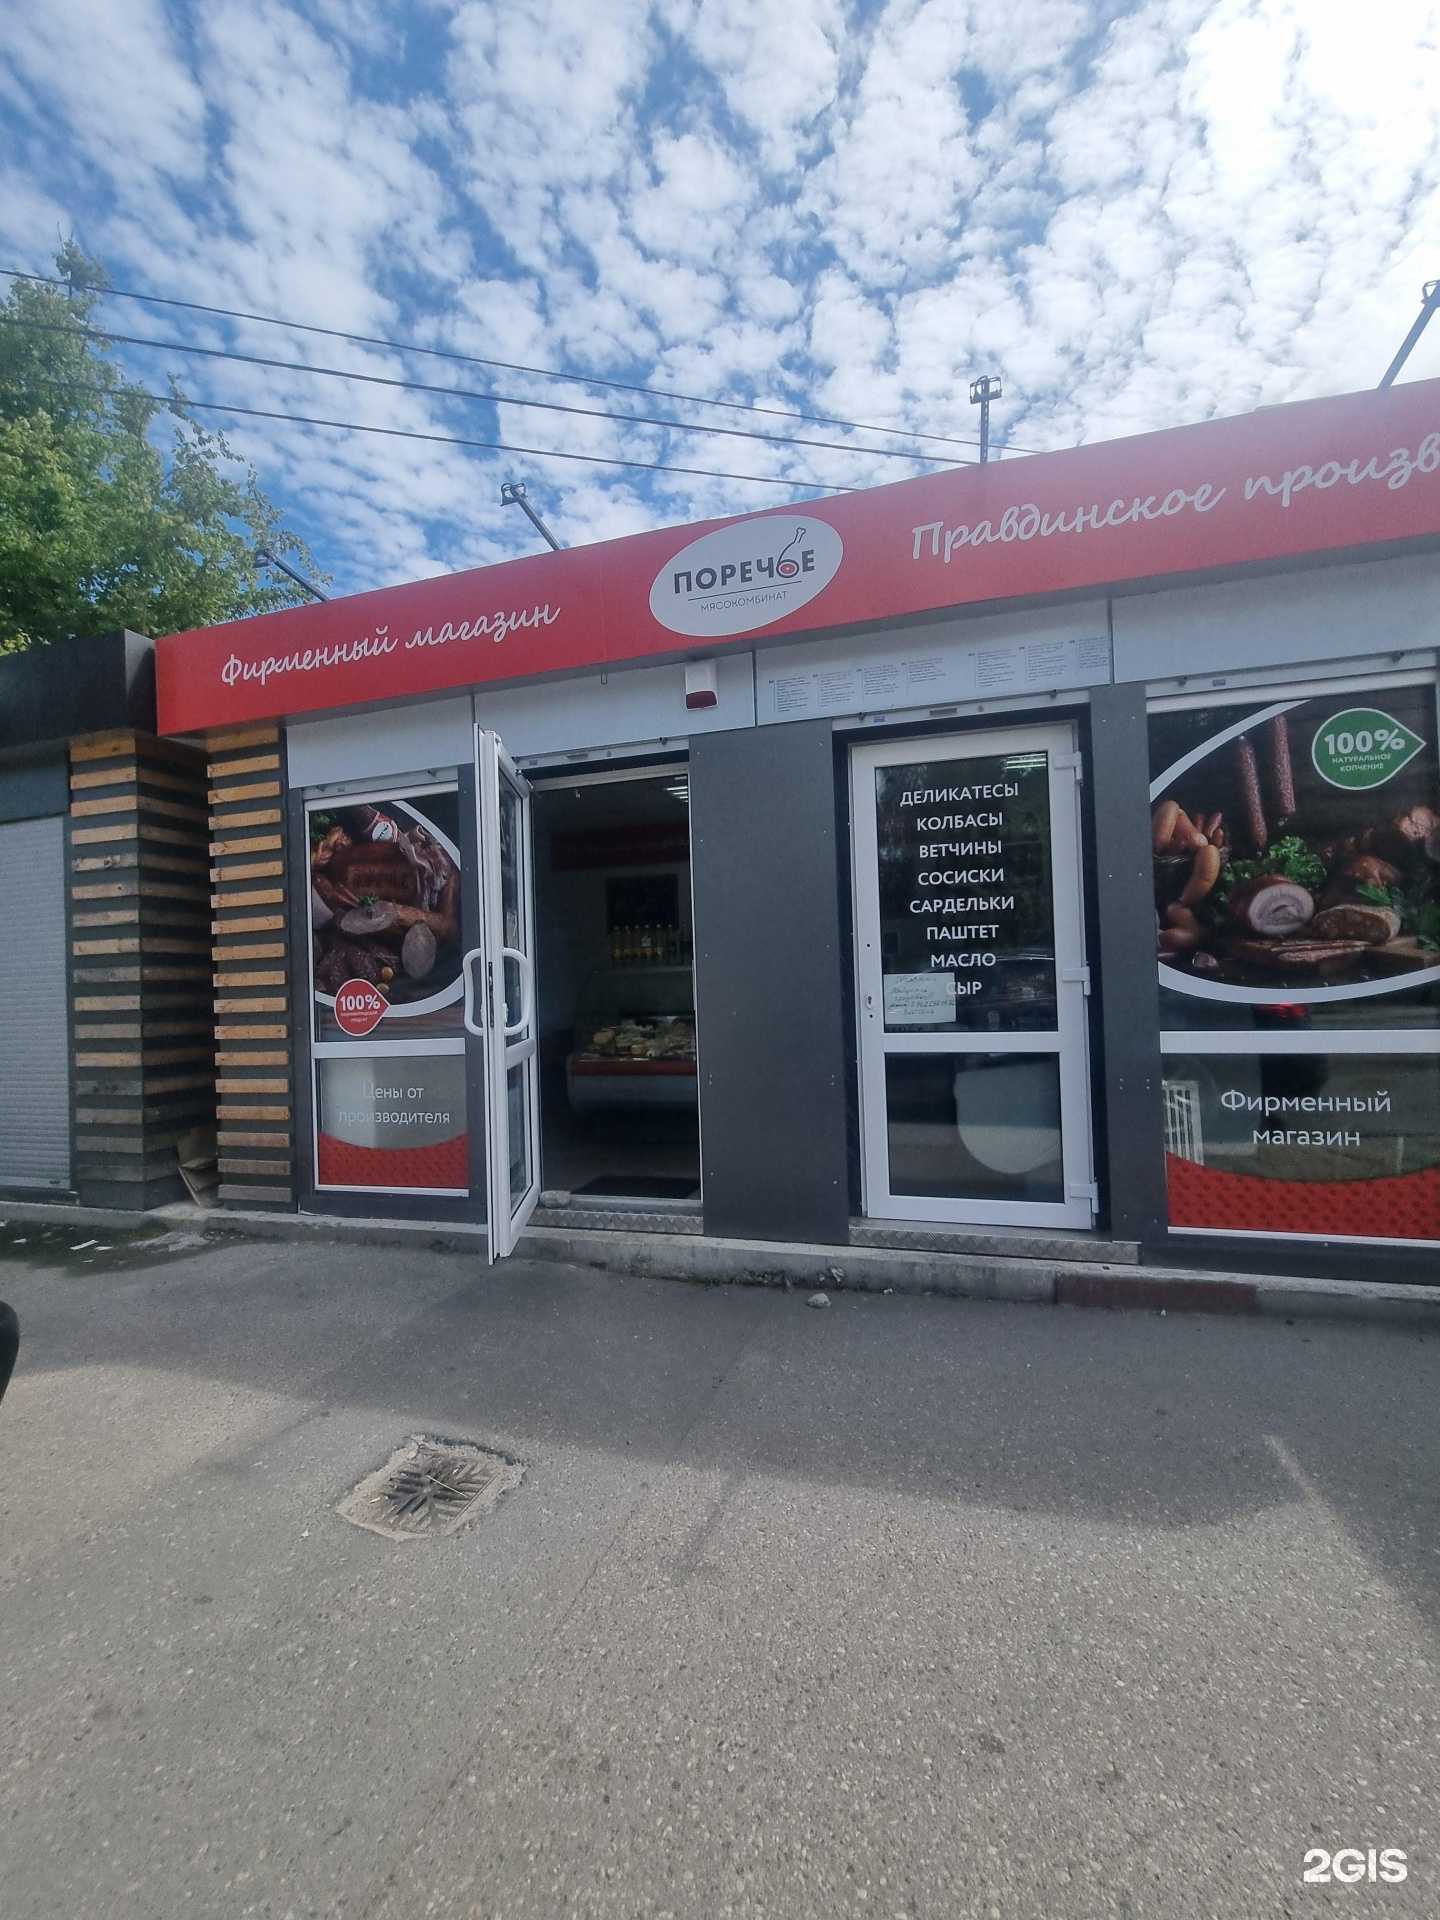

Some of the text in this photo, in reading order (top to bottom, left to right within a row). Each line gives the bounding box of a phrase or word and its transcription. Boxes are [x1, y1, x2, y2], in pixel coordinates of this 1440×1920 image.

[911, 432, 1440, 563] Правдинское произв
[673, 530, 817, 595] ПОРЕЧЬЕ
[701, 591, 788, 612] МЯСОКОМБИНАТ
[220, 603, 562, 686] Фирменный магазин
[1324, 728, 1406, 755] 100%
[900, 782, 1019, 807] ДЕЛИКАТЕСЫ
[916, 812, 1004, 832] КОЛБАСЫ
[919, 840, 1002, 859] ВЕТЧИНЫ
[917, 868, 1005, 886] СОСИСКИ
[909, 896, 1015, 914] САРДЕЛЬКИ
[926, 924, 1000, 941] ПАШТЕТ
[930, 953, 997, 968] МАСЛО
[340, 994, 381, 1011] 100%
[407, 1086, 424, 1099] от
[1220, 1089, 1392, 1117] Фирменный
[1252, 1129, 1361, 1147] магазин
